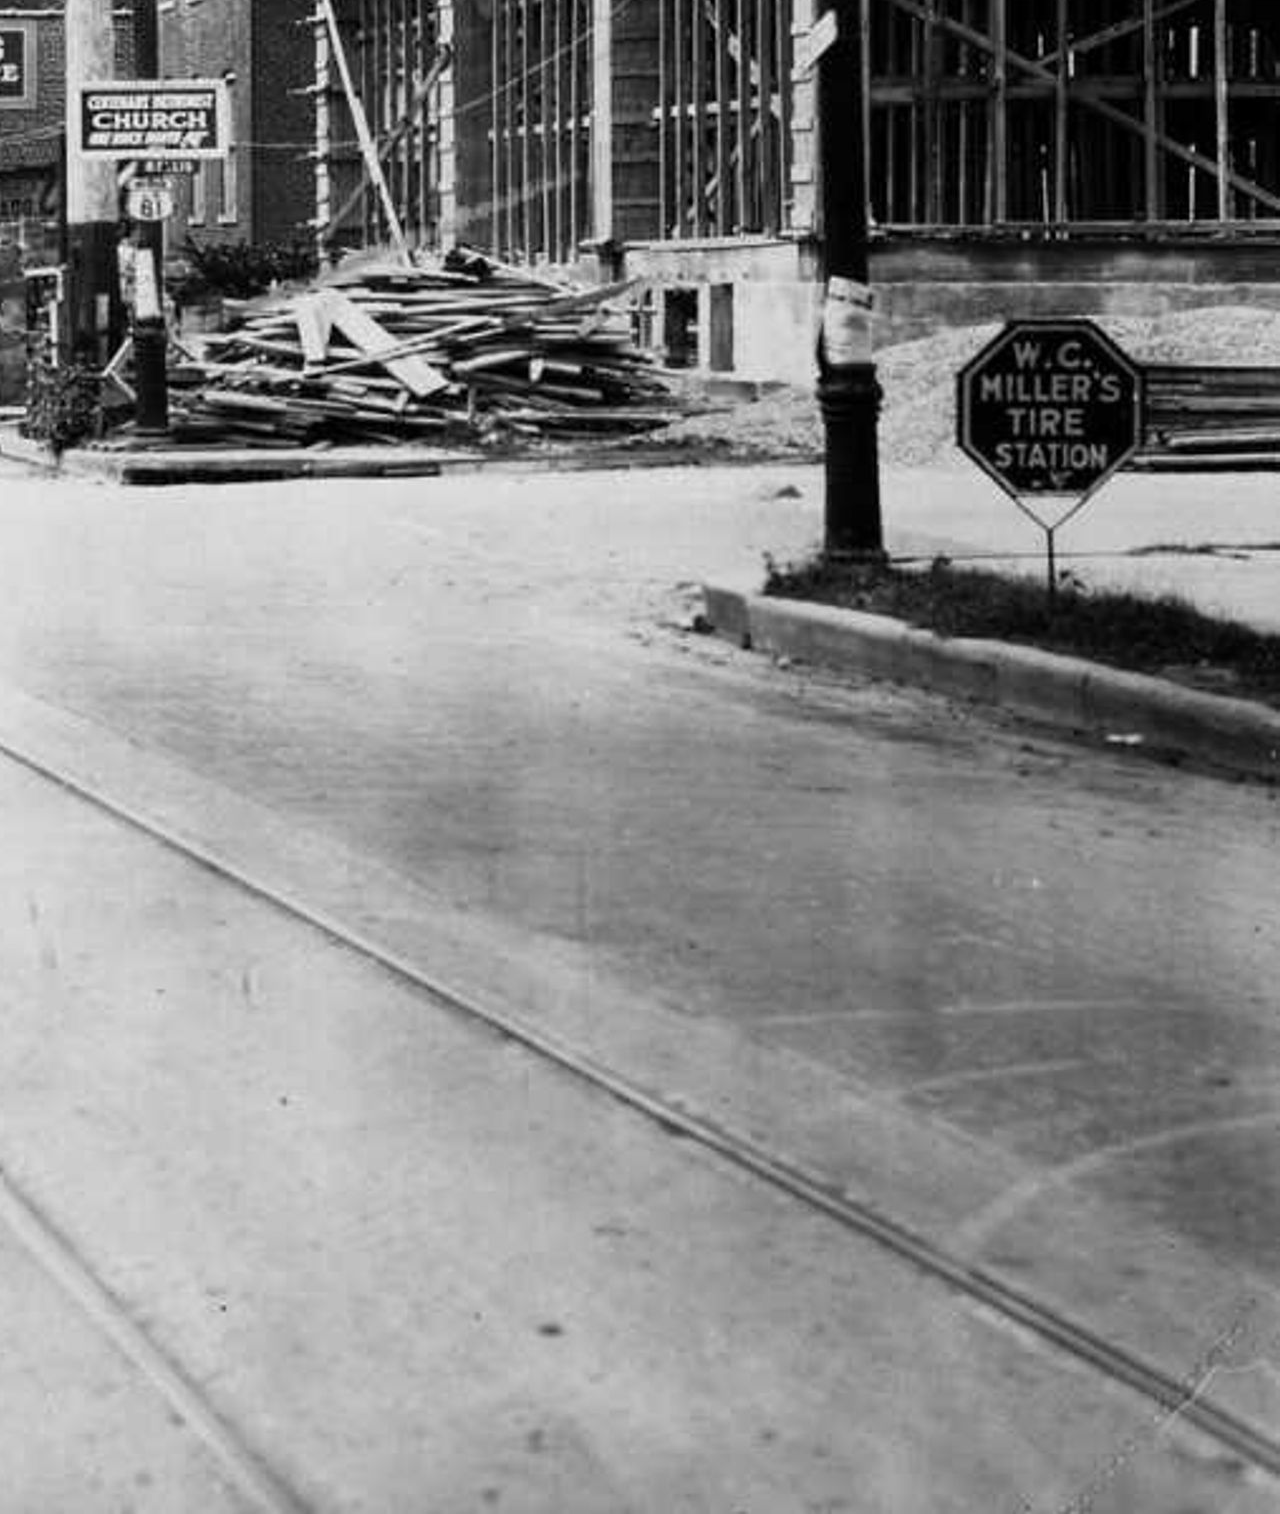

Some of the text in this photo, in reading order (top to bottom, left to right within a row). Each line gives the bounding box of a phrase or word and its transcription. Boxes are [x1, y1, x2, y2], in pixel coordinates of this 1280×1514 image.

[92, 110, 208, 130] CHURCH
[980, 371, 1121, 403] MILLER'S
[1006, 407, 1085, 436] TIRE
[995, 442, 1108, 469] STATION
